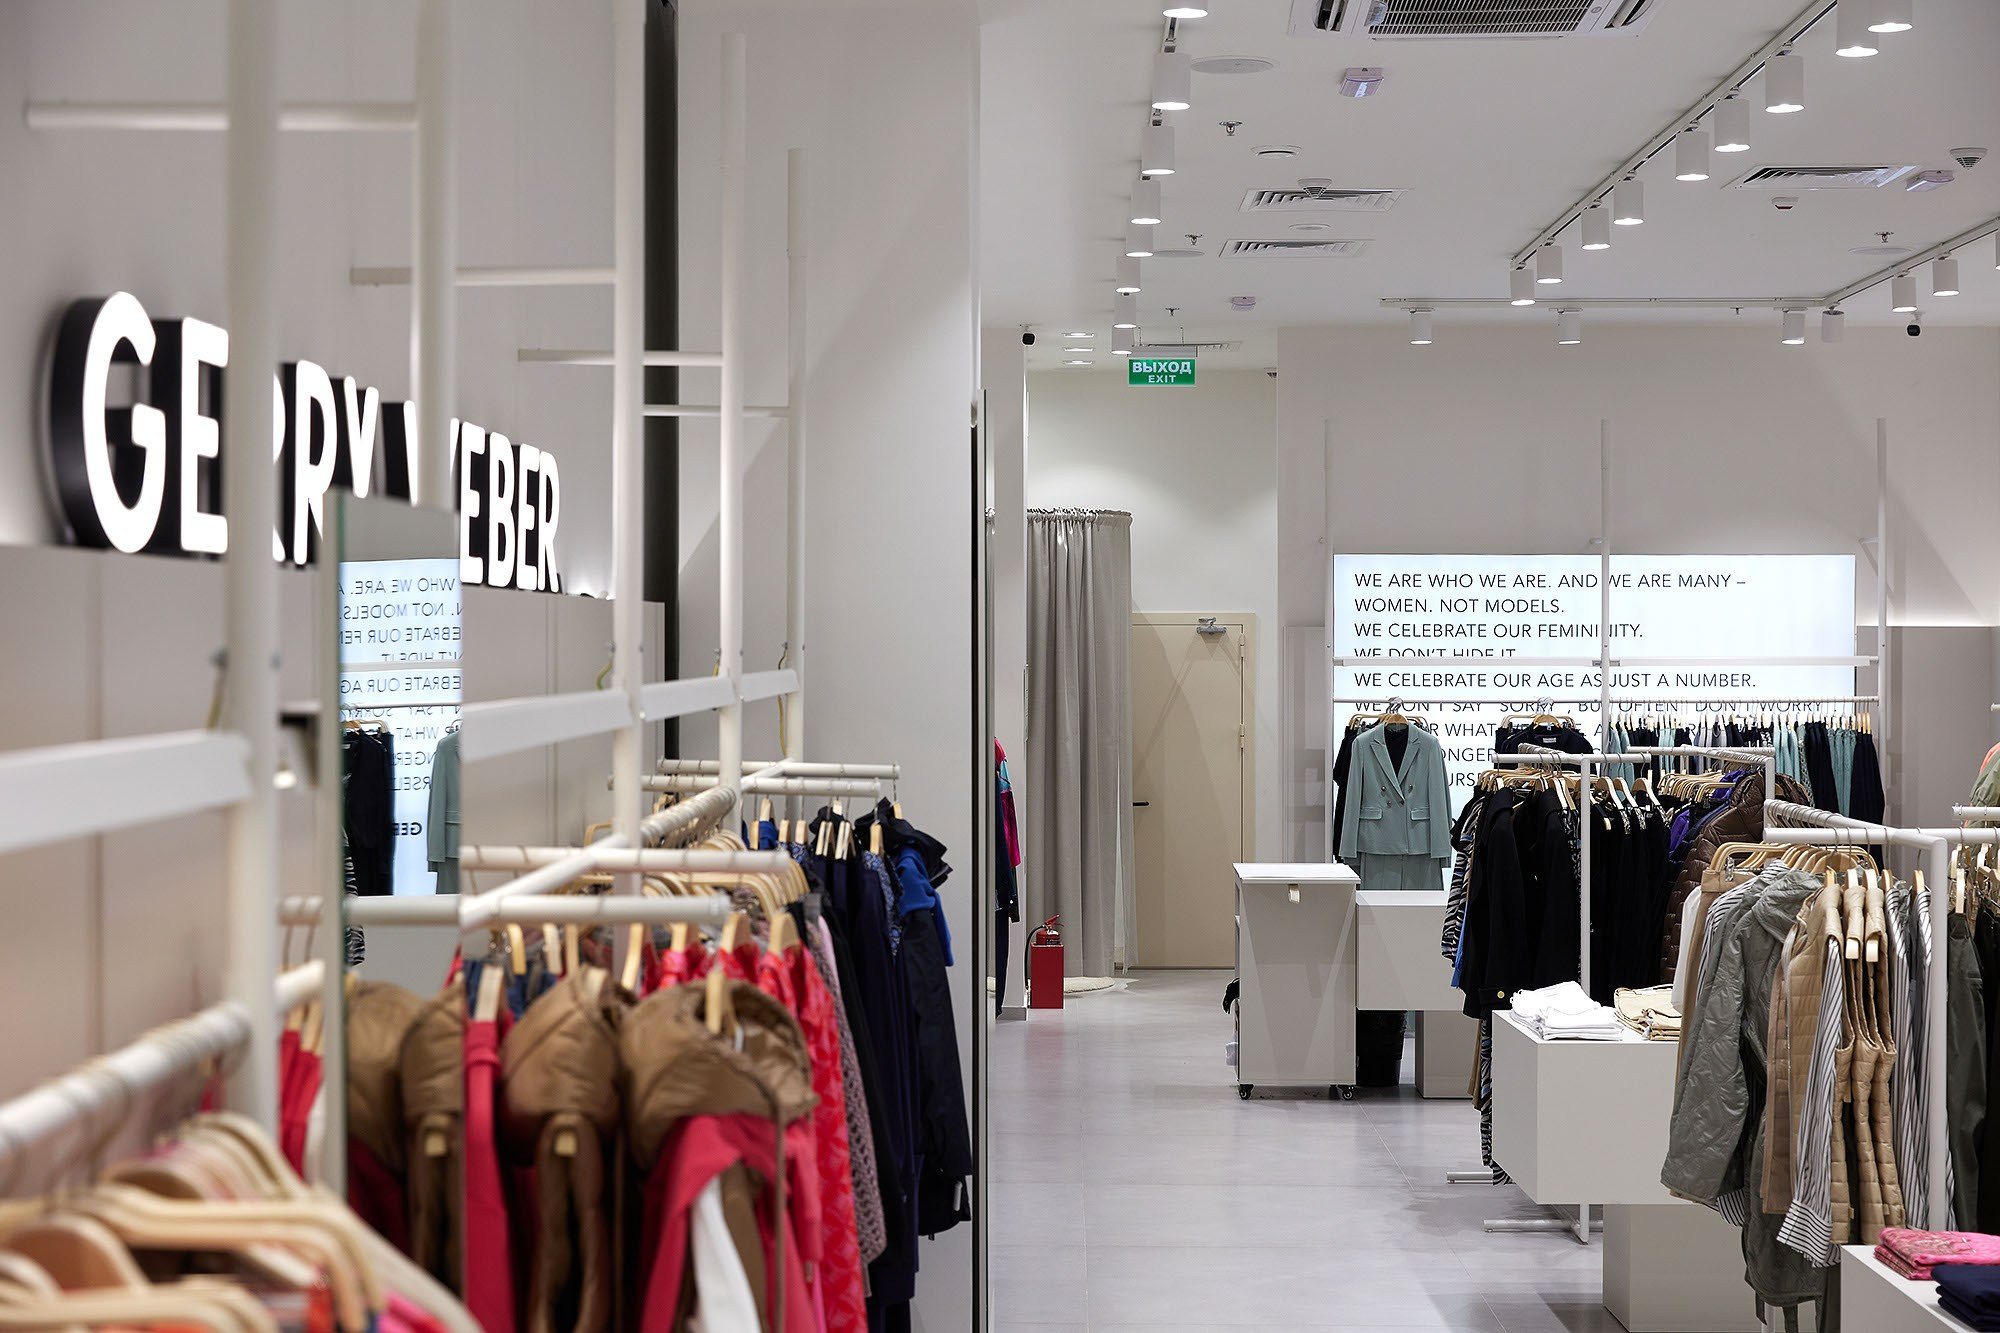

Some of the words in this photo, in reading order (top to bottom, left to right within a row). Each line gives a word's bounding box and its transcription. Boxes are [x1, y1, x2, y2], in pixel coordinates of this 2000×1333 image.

[1132, 361, 1192, 375] ВЫХОД
[1148, 375, 1176, 383] EXIT
[1354, 573, 1382, 588] WE
[1388, 573, 1422, 588] ARE
[1428, 573, 1473, 588] WHO
[1479, 574, 1507, 588] WE
[1513, 574, 1552, 588] ARE.
[1557, 574, 1598, 588] AND
[1637, 574, 1671, 588] ARE
[1678, 574, 1732, 588] MANY
[1354, 598, 1433, 613] WOMEN.
[1440, 598, 1479, 613] NOT
[1485, 598, 1565, 613] MODELS.
[1354, 623, 1382, 638] WE
[1388, 623, 1487, 638] CELEBRATE
[1493, 623, 1532, 638] OUR
[1354, 673, 1382, 687] WE
[1388, 673, 1487, 688] CELEBRATE
[1493, 673, 1532, 688] OUR
[1537, 673, 1575, 688] AGE
[1580, 673, 1602, 688] AS
[1609, 673, 1651, 688] JUST
[1656, 673, 1670, 687] A
[1675, 673, 1756, 688] NUMBER.
[1444, 723, 1497, 737] WHAT
